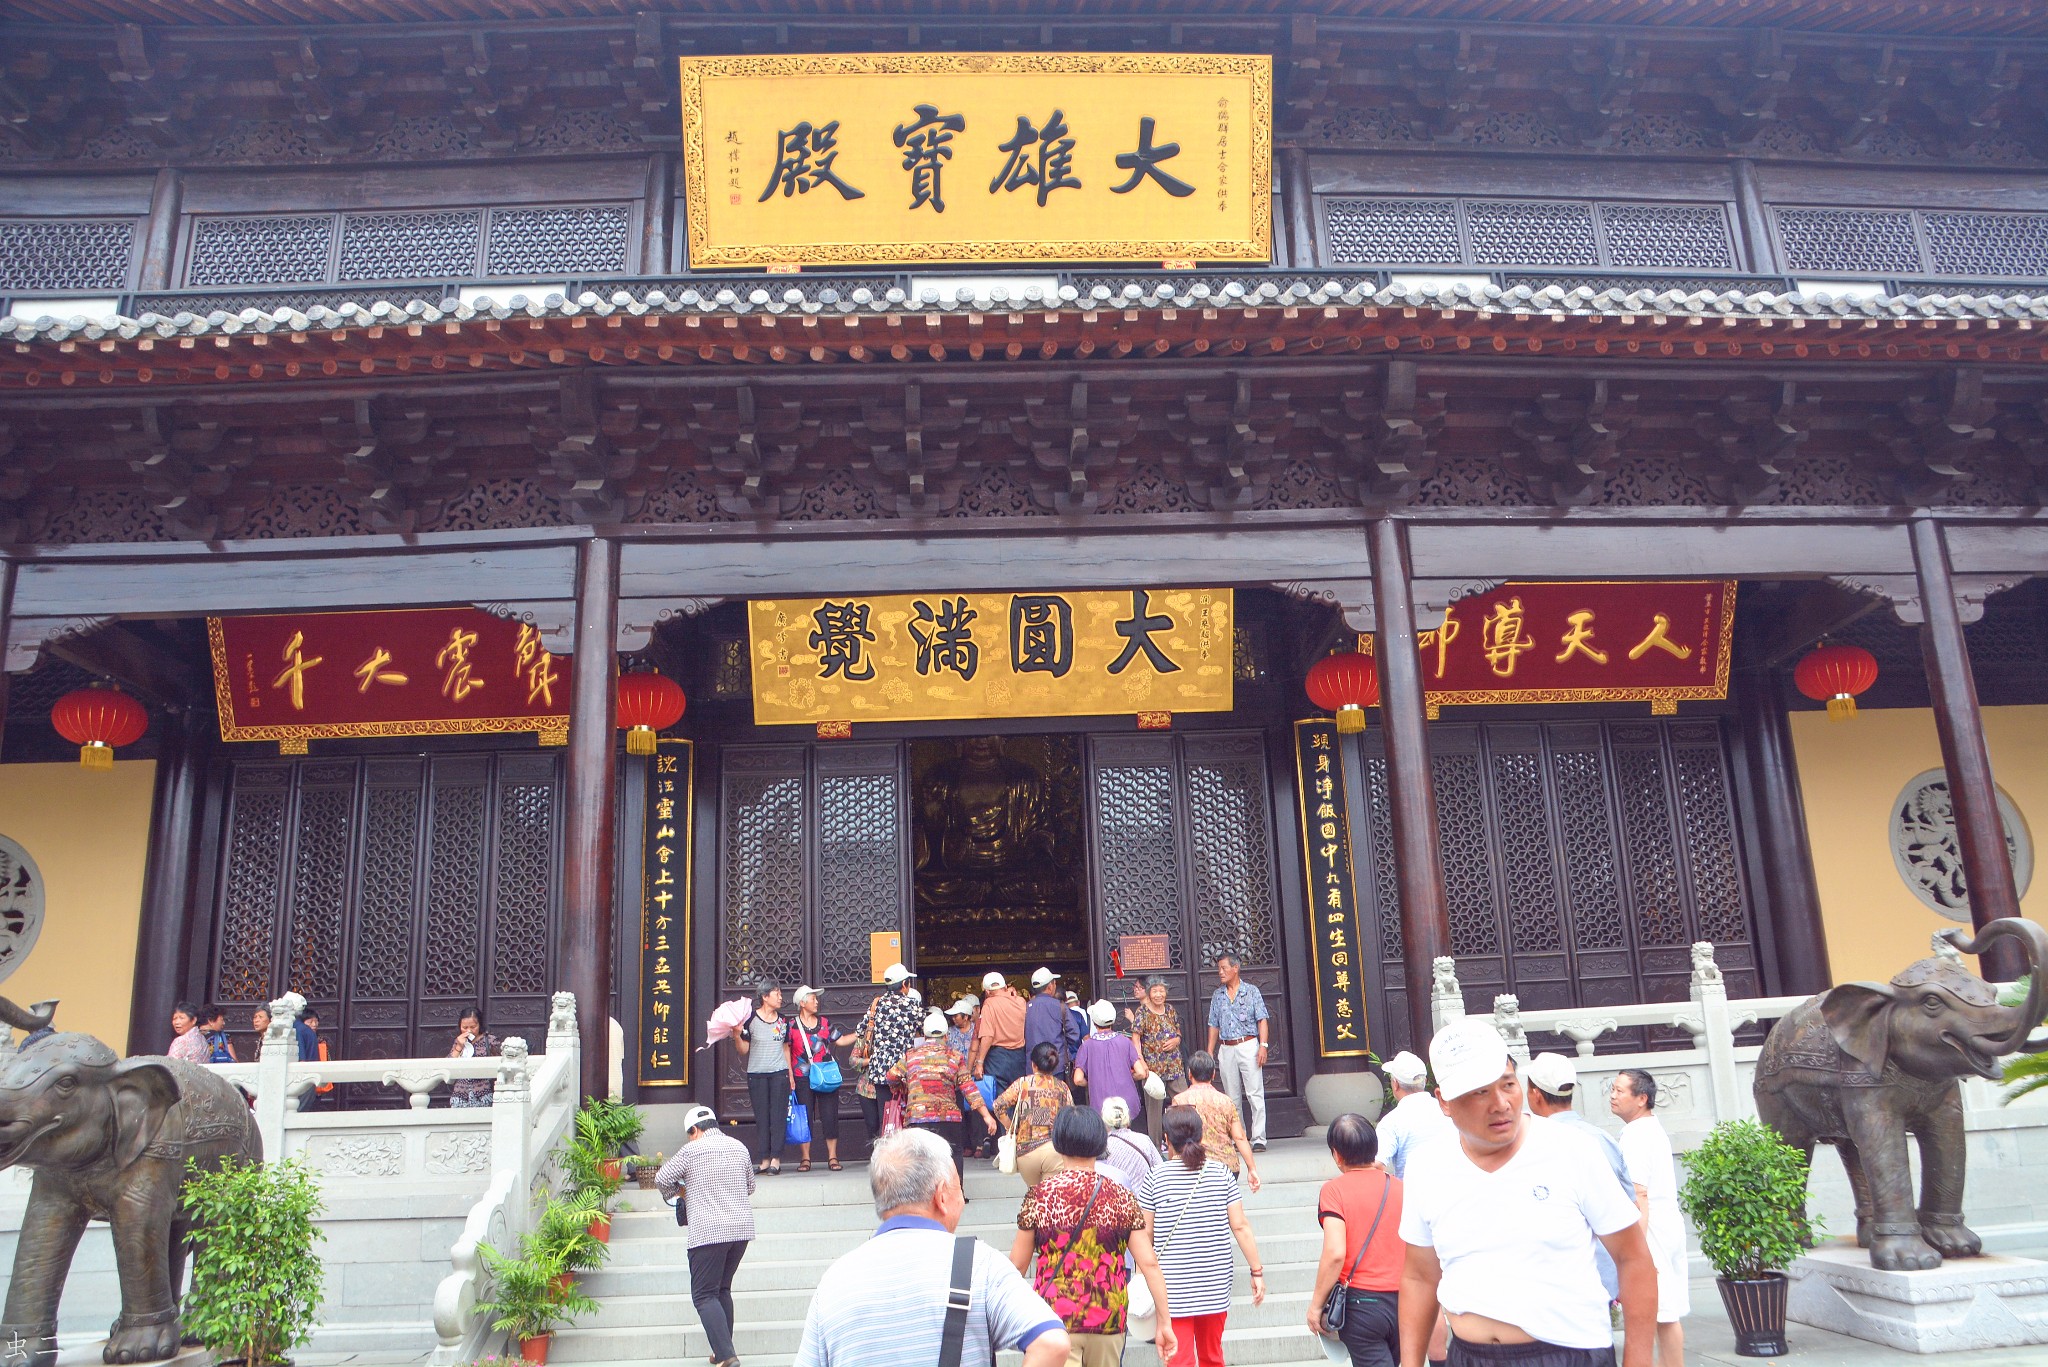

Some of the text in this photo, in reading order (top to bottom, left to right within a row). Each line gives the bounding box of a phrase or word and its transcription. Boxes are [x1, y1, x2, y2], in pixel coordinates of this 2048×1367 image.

[759, 104, 1196, 213] 大雄寶殿
[809, 590, 1181, 681] 大圓滿覺
